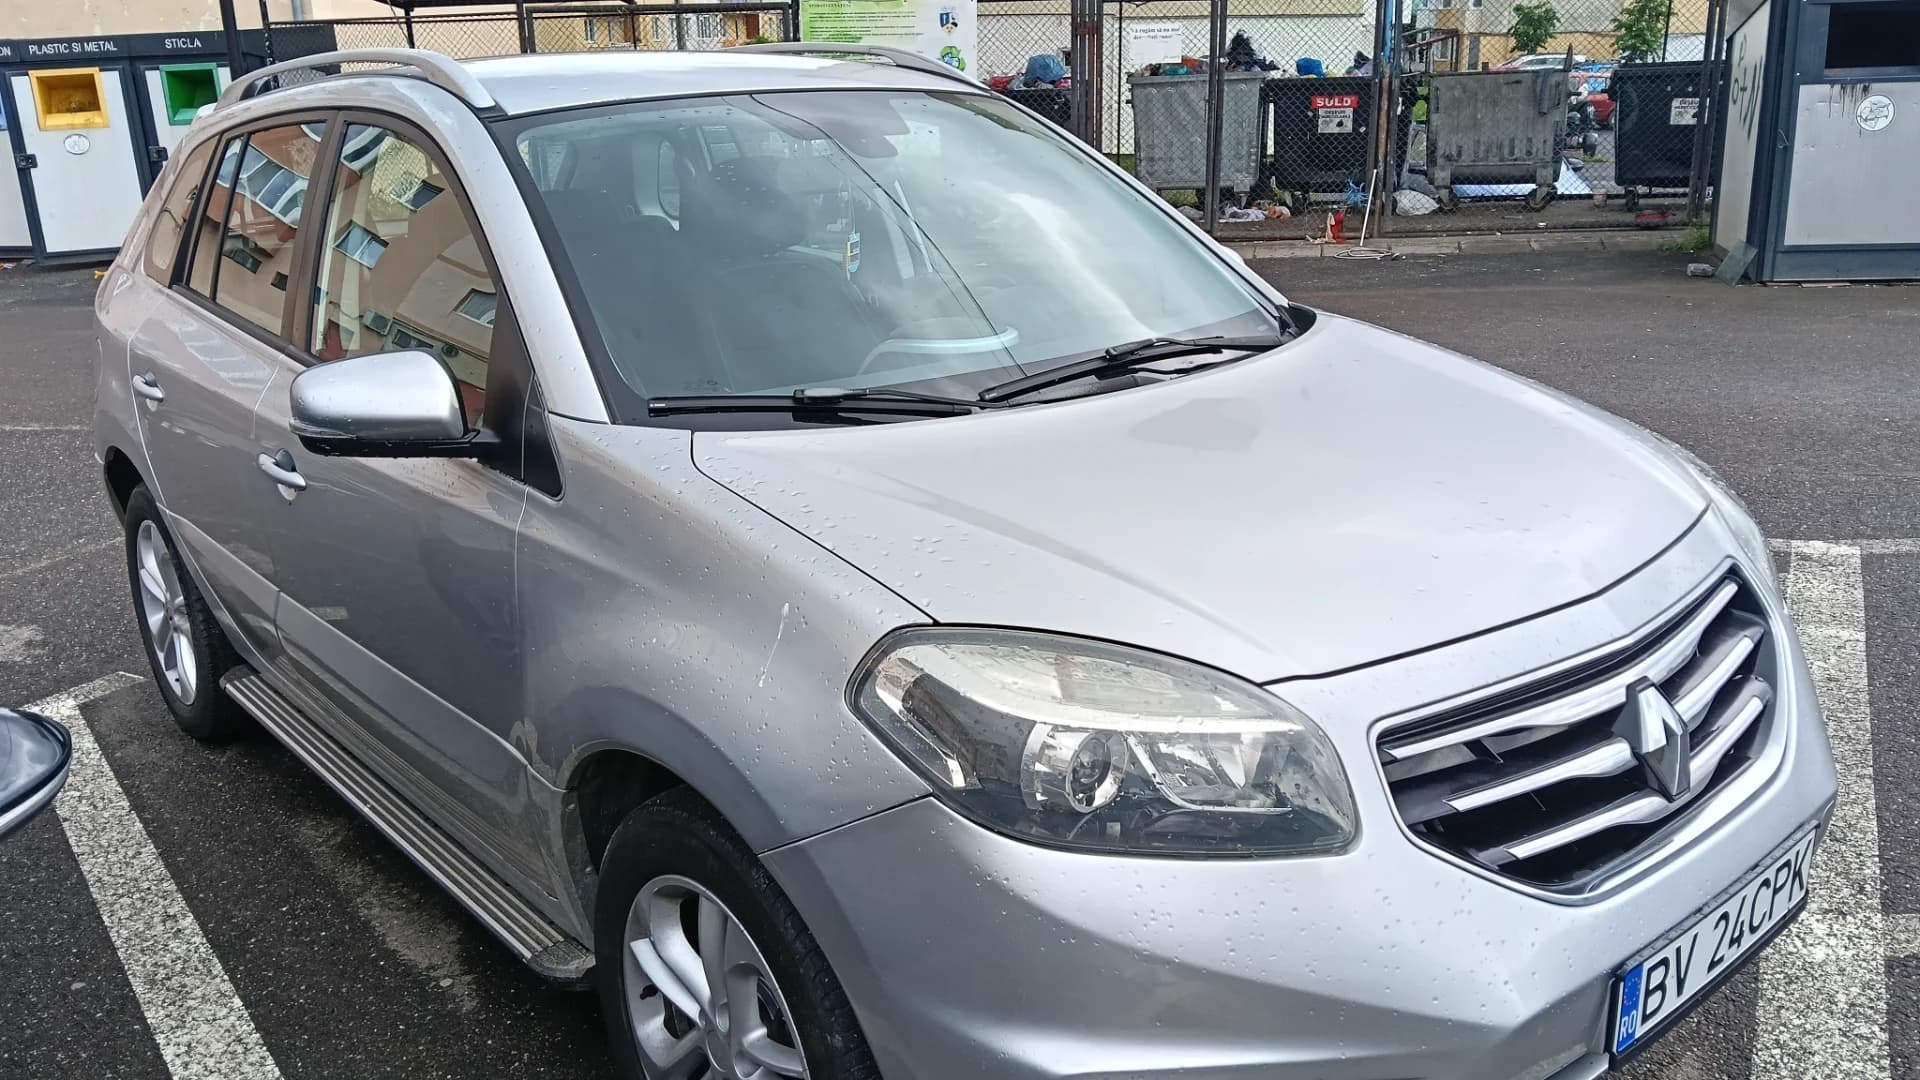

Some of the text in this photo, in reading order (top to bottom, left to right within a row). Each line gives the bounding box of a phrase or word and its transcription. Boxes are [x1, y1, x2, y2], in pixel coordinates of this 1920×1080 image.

[28, 41, 118, 55] PLASTIC SI METAL
[164, 37, 202, 48] STICLA
[1641, 931, 1699, 1026] BV
[1619, 1010, 1637, 1041] RO
